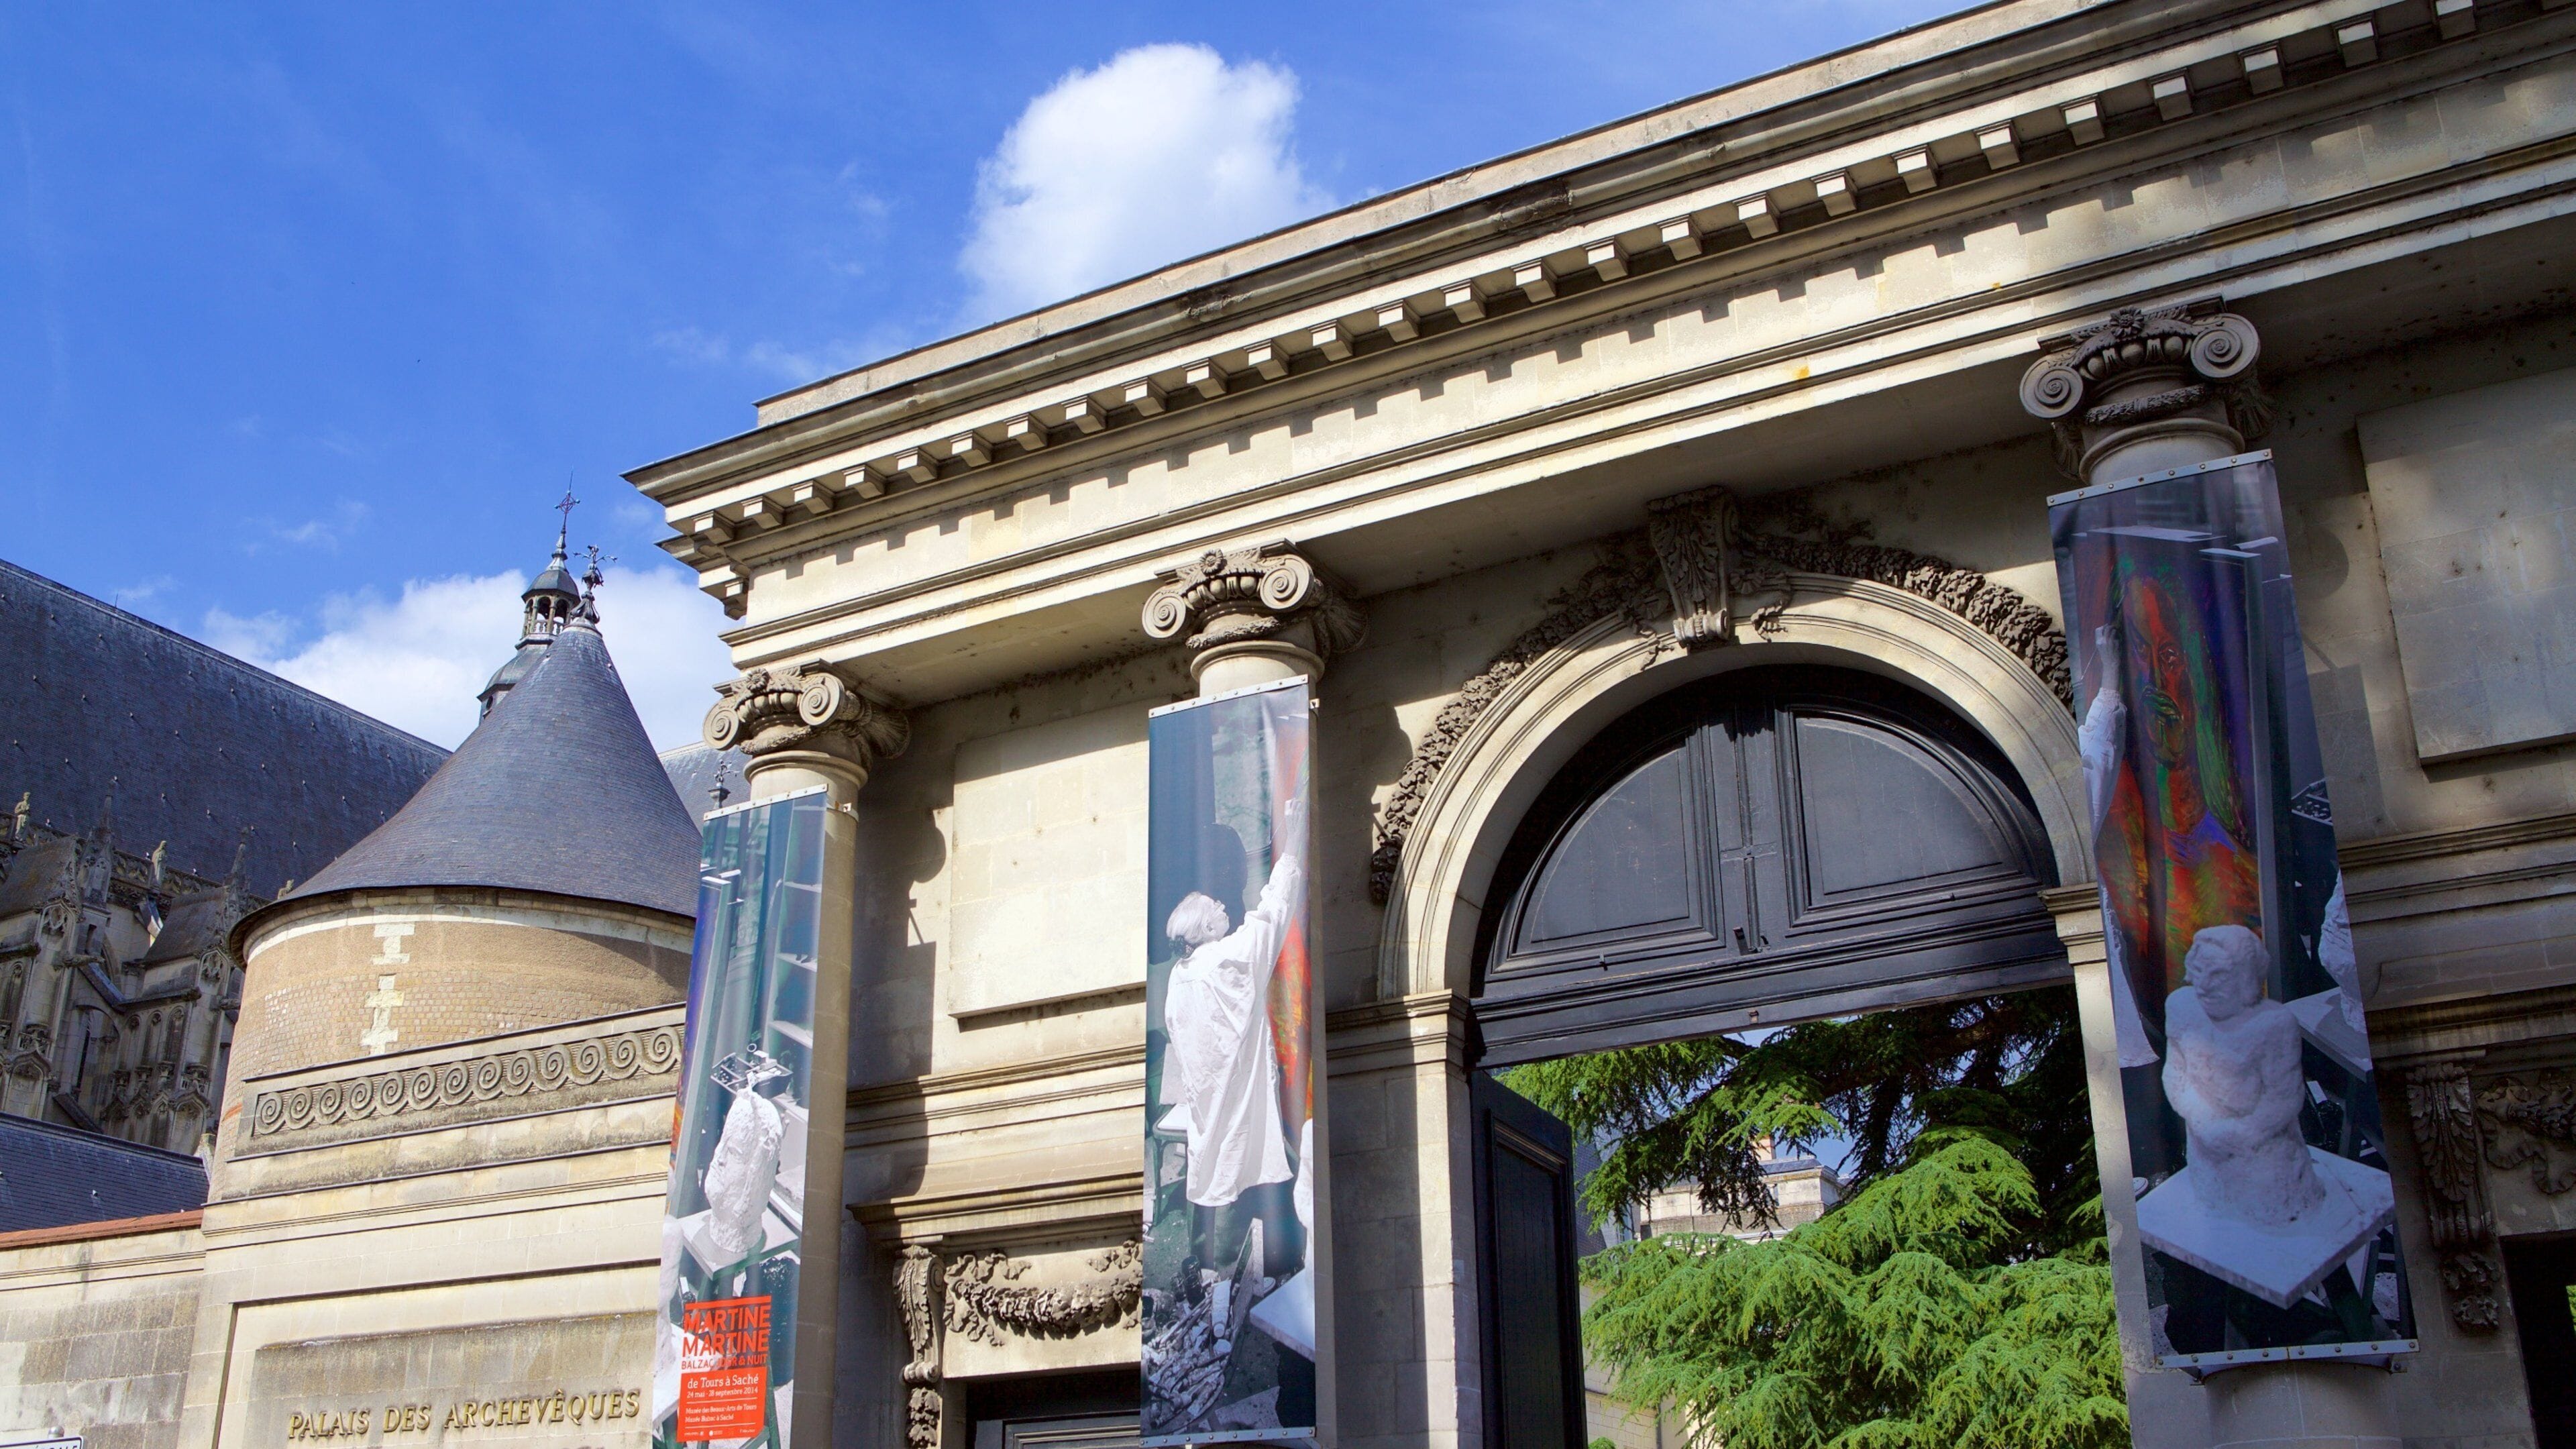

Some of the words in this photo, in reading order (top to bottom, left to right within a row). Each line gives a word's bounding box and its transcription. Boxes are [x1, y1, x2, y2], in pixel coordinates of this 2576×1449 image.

[684, 1305, 771, 1333] MARTINE
[682, 1329, 770, 1357] MARTINE
[682, 1358, 714, 1370] BALZAC
[739, 1356, 746, 1365] &
[747, 1354, 767, 1364] NUIT
[688, 1378, 698, 1389] de
[700, 1377, 724, 1388] Tours
[725, 1375, 731, 1386] à
[732, 1373, 759, 1386] Saché
[715, 1389, 743, 1397] septembre
[288, 1409, 370, 1439] PALAIS
[383, 1405, 431, 1433] DES
[443, 1388, 641, 1429] ARCHEVÊQUES
